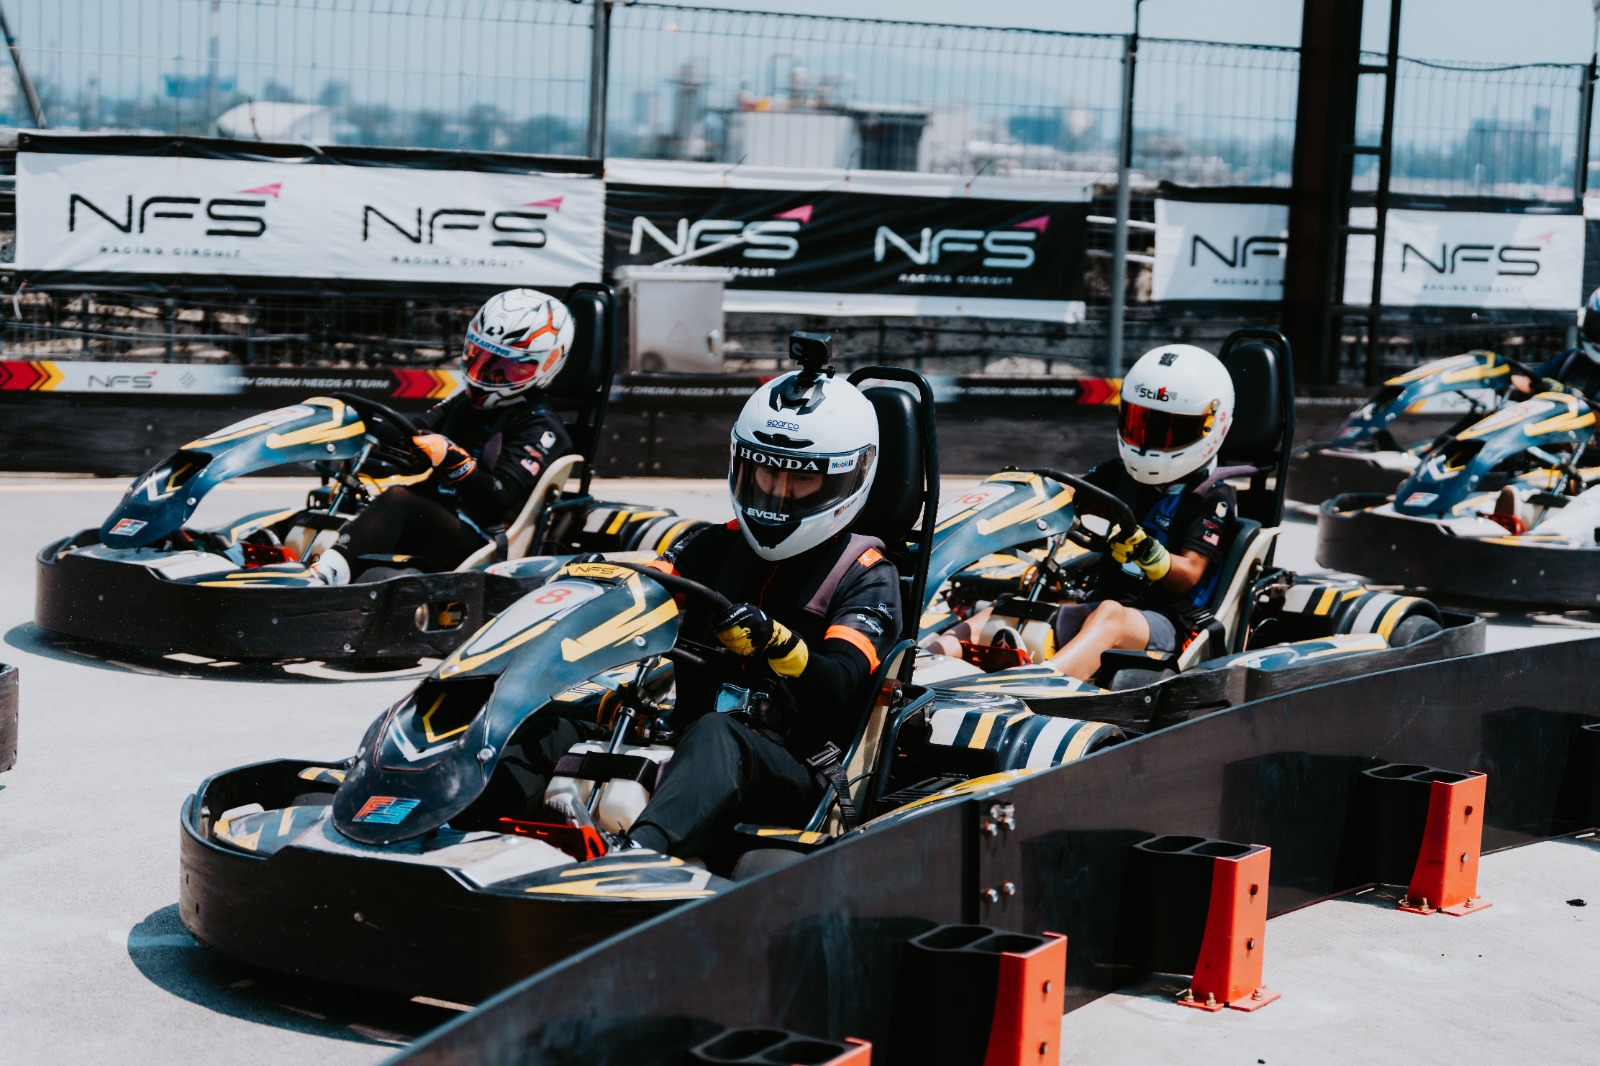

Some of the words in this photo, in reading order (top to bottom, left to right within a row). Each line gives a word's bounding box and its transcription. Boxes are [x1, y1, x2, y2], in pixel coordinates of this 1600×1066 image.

[69, 193, 267, 237] NFS
[362, 205, 548, 248] NFS
[629, 216, 801, 260] NFS
[100, 245, 163, 256] RACING
[172, 247, 241, 257] CIRCUIT
[874, 226, 1037, 268] NFS
[1191, 235, 1288, 268] NF
[390, 255, 451, 266] RACING
[1401, 243, 1541, 276] NFS
[88, 374, 153, 390] NFS
[255, 377, 302, 388] DREAM
[302, 378, 342, 389] NEEDS
[354, 379, 390, 389] TEAM
[766, 419, 800, 431] sparco
[740, 447, 820, 471] HONDA
[831, 461, 848, 469] Mobil
[747, 507, 790, 522] EVOLT
[574, 566, 616, 575] NFS
[534, 588, 573, 605] 8
